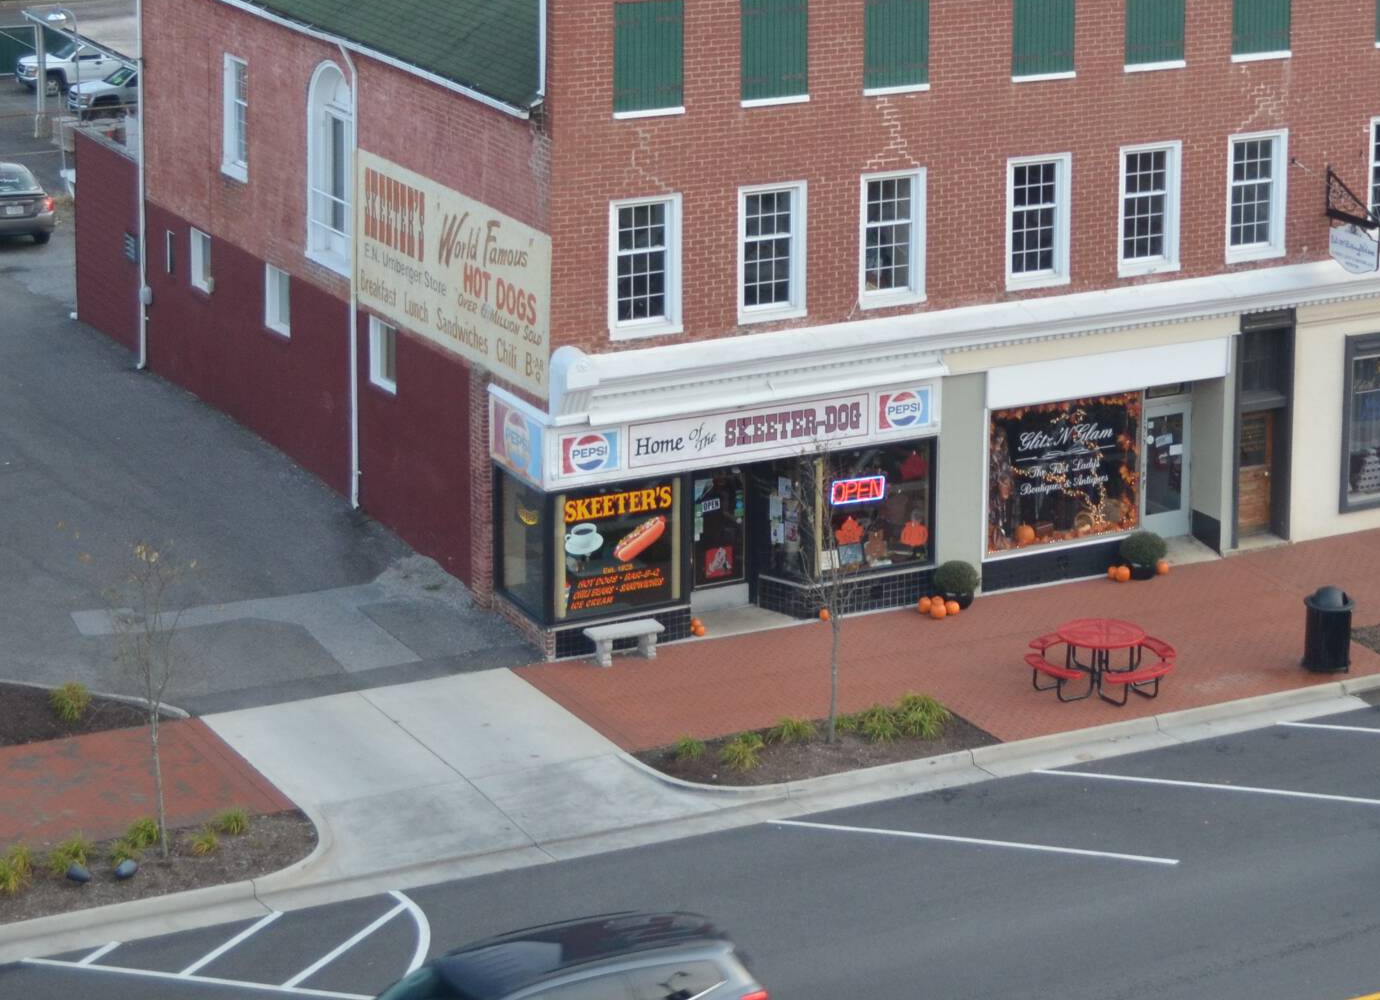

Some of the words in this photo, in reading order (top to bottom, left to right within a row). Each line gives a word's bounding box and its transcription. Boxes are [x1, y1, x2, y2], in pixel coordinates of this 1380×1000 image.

[365, 167, 425, 262] SKEETER'S
[382, 253, 422, 284] Umberger
[424, 271, 447, 297] Store
[463, 262, 491, 303] HOT
[496, 278, 537, 326] DOGS
[360, 269, 397, 307] Breakfast
[404, 291, 429, 324] Lunch
[435, 306, 489, 355] Sandwiches
[496, 337, 518, 369] Chili
[490, 309, 520, 335] MILLION
[523, 325, 542, 346] SOLD
[887, 402, 920, 416] PEPSI
[505, 430, 528, 450] PEPSI
[634, 433, 684, 457] Home
[689, 421, 706, 442] of
[724, 402, 862, 448] SKEETER-DOG
[1018, 430, 1053, 452] Glitz
[1073, 422, 1113, 444] Glam
[572, 445, 608, 460] PEPSI
[564, 485, 673, 522] SKEETER'S
[833, 478, 883, 502] OPEN
[702, 499, 720, 512] OPEN
[596, 575, 618, 586] DOGS
[571, 600, 585, 610] ICE
[586, 596, 614, 607] CREAM
